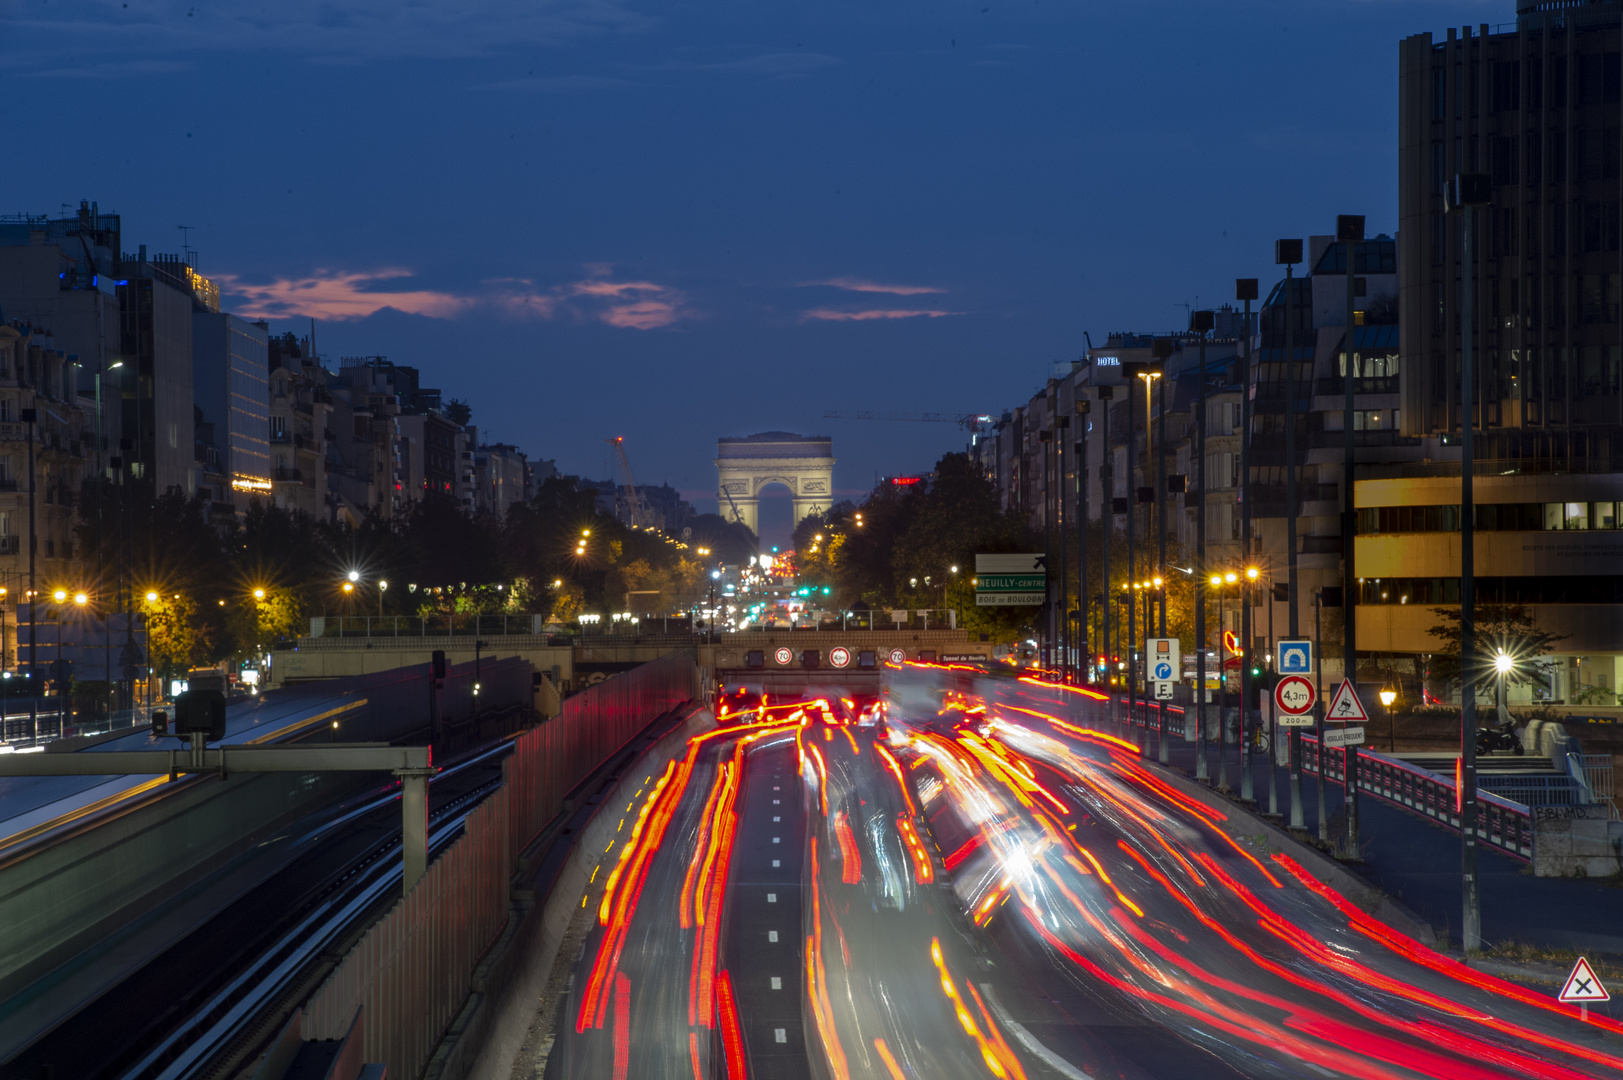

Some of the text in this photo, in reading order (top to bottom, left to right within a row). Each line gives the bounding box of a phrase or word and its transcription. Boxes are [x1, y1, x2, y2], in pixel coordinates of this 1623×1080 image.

[1097, 357, 1120, 366] HOTEL
[979, 579, 1046, 587] NEUILLY-CENTRE
[1160, 684, 1167, 696] E
[1283, 690, 1307, 701] 4,3m
